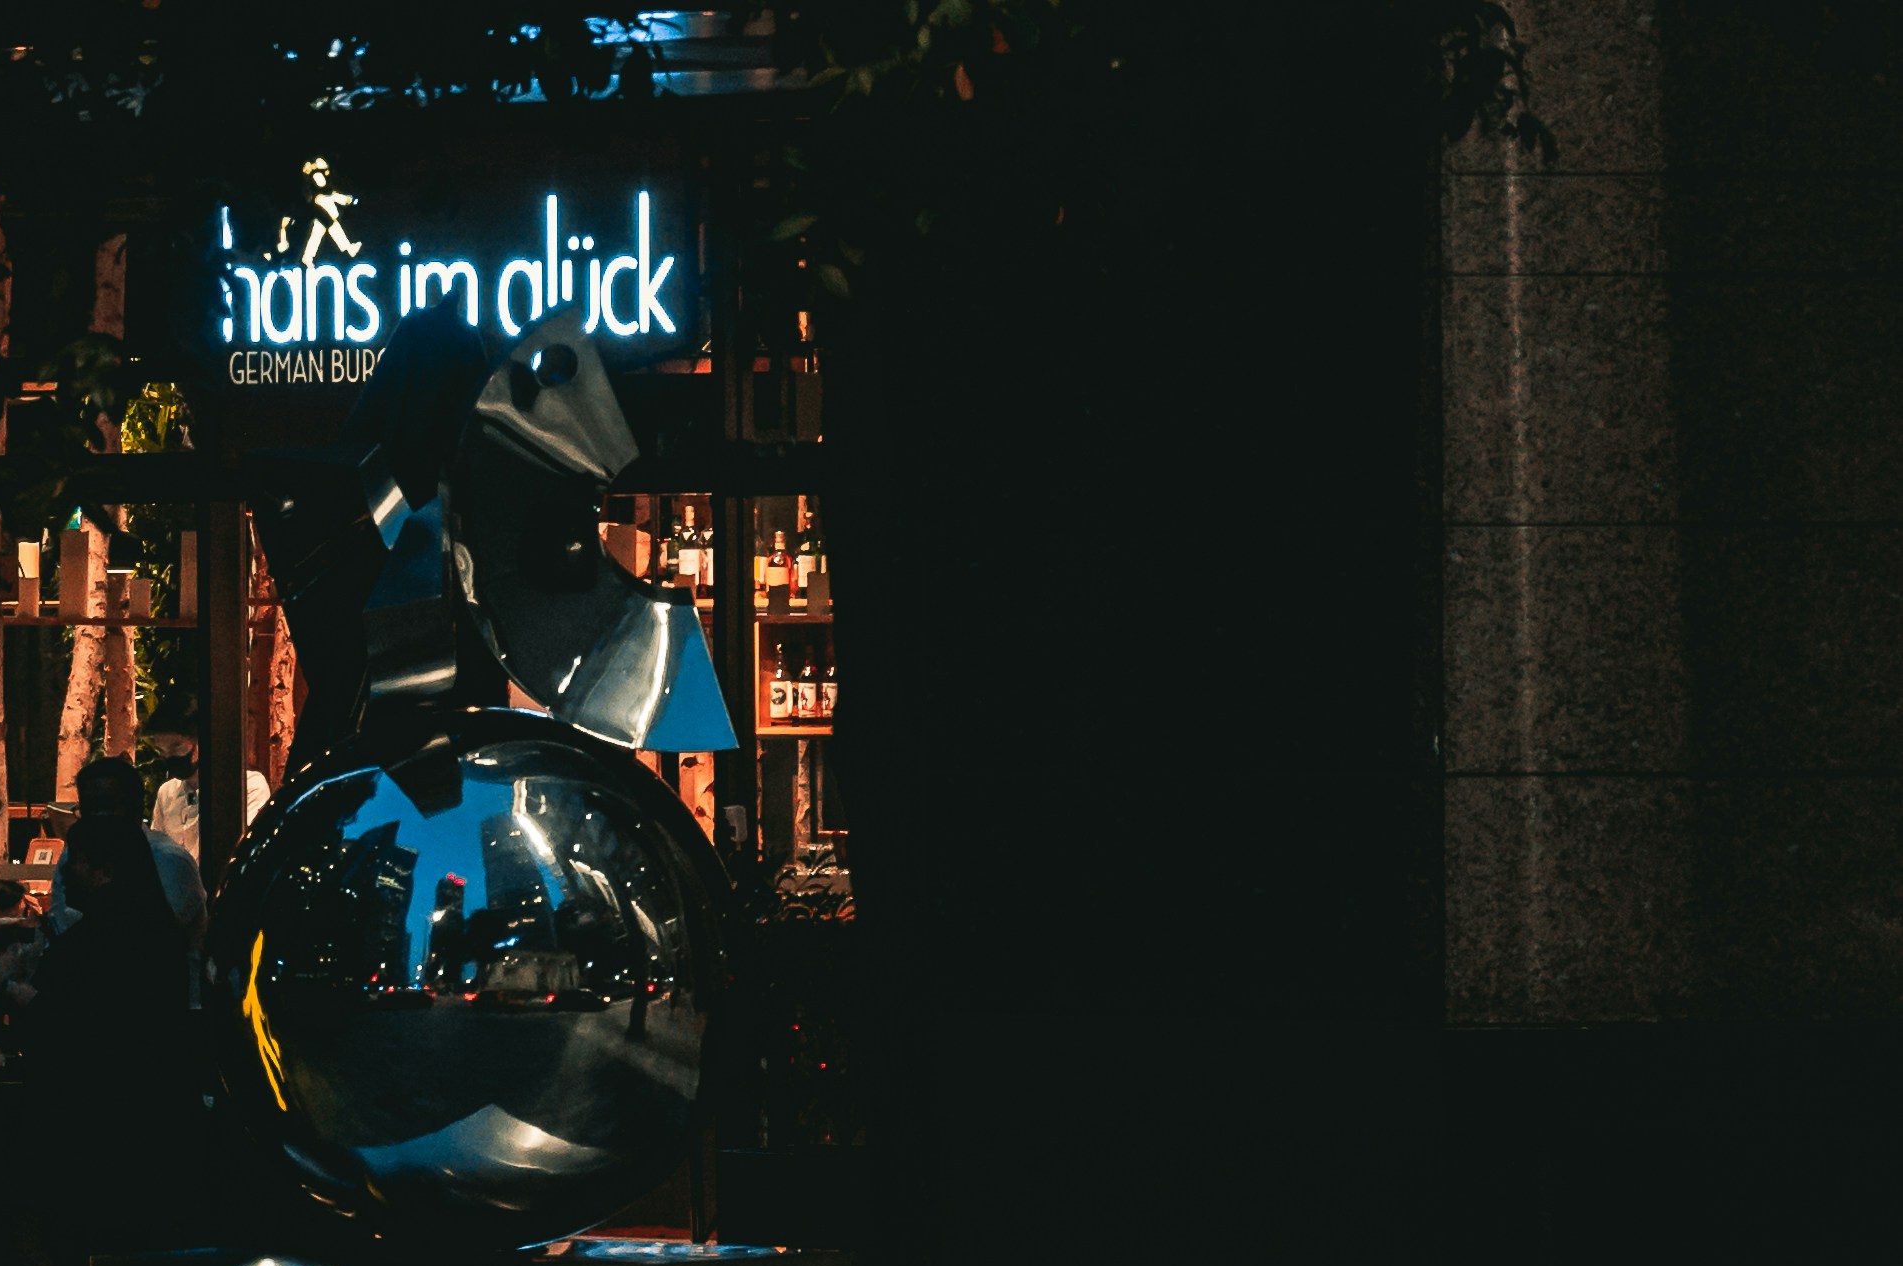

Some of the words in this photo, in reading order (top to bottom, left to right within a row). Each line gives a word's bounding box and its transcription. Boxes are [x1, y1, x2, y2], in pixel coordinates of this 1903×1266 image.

[220, 205, 382, 343] hans
[399, 241, 481, 328] im
[498, 190, 678, 338] glück
[229, 349, 325, 386] GERMAN
